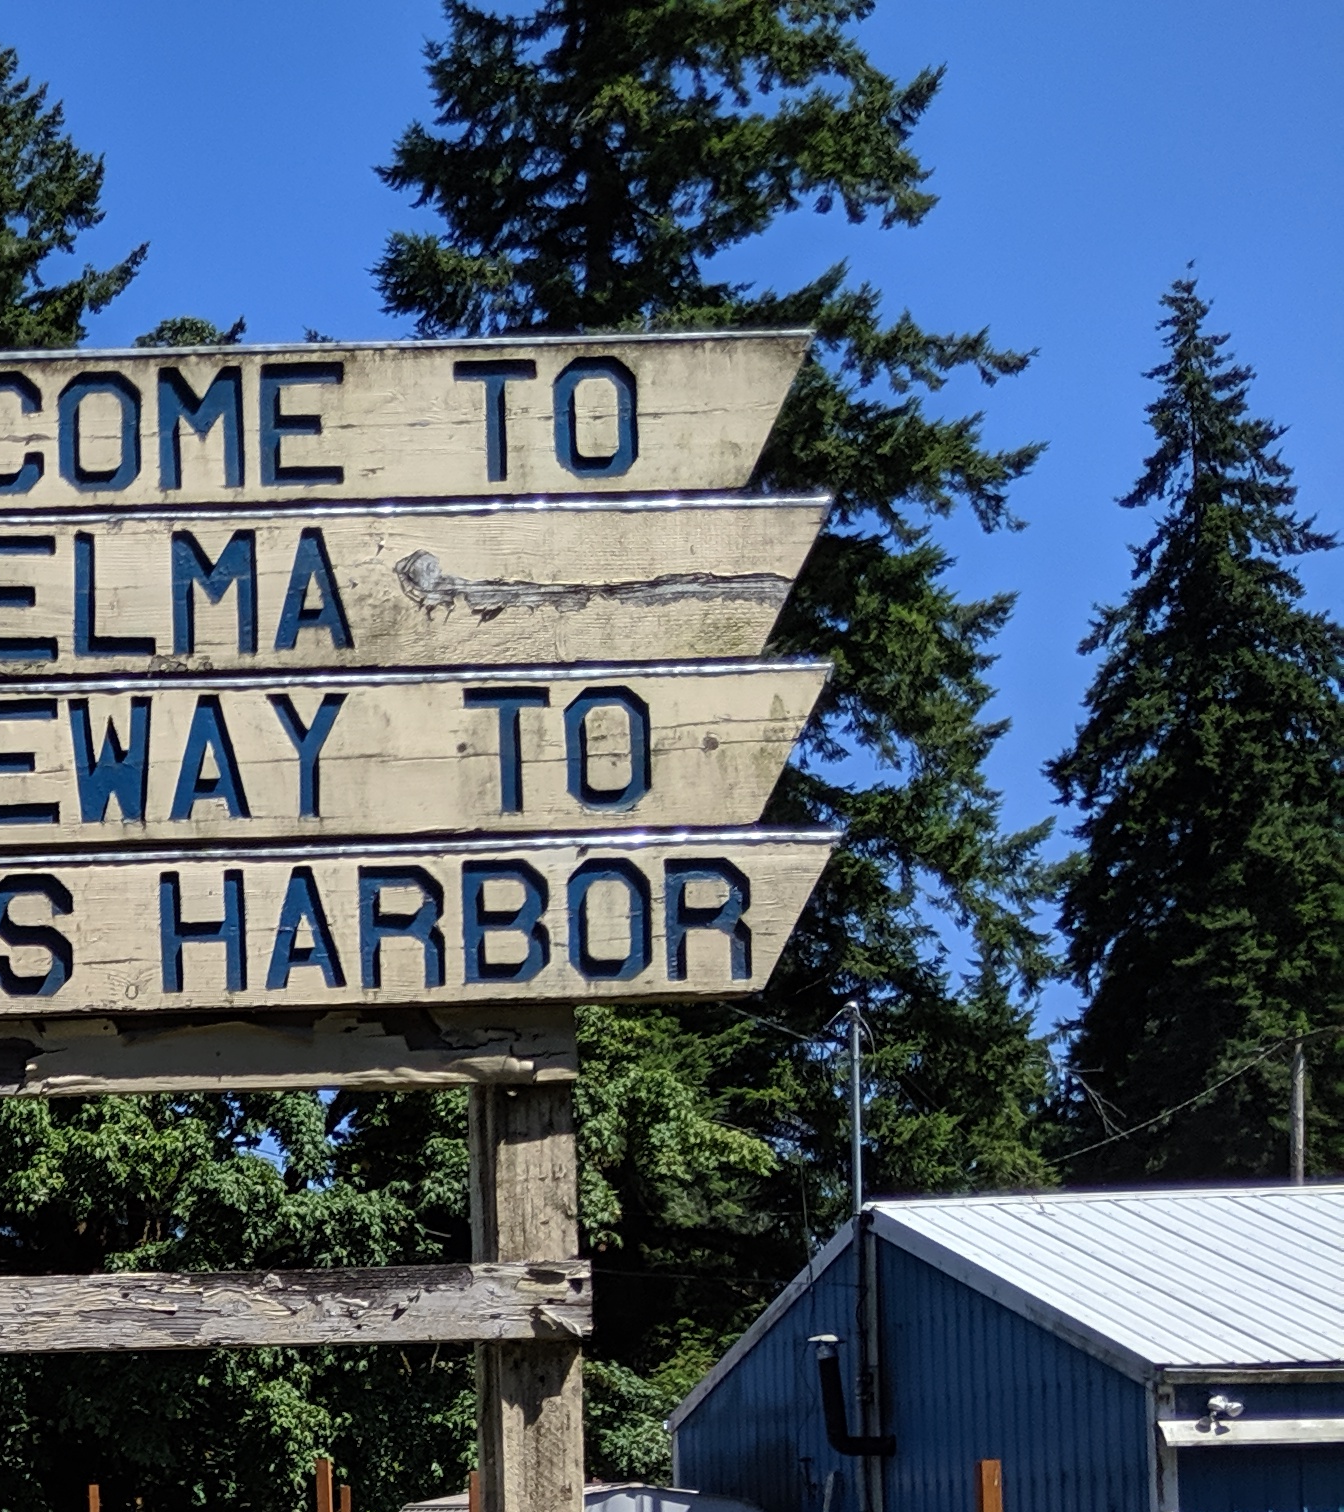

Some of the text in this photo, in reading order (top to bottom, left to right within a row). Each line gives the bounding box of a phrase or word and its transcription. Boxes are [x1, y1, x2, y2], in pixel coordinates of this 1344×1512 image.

[453, 356, 638, 482] TO
[463, 685, 651, 813] TO
[159, 857, 752, 993] HARBOR
